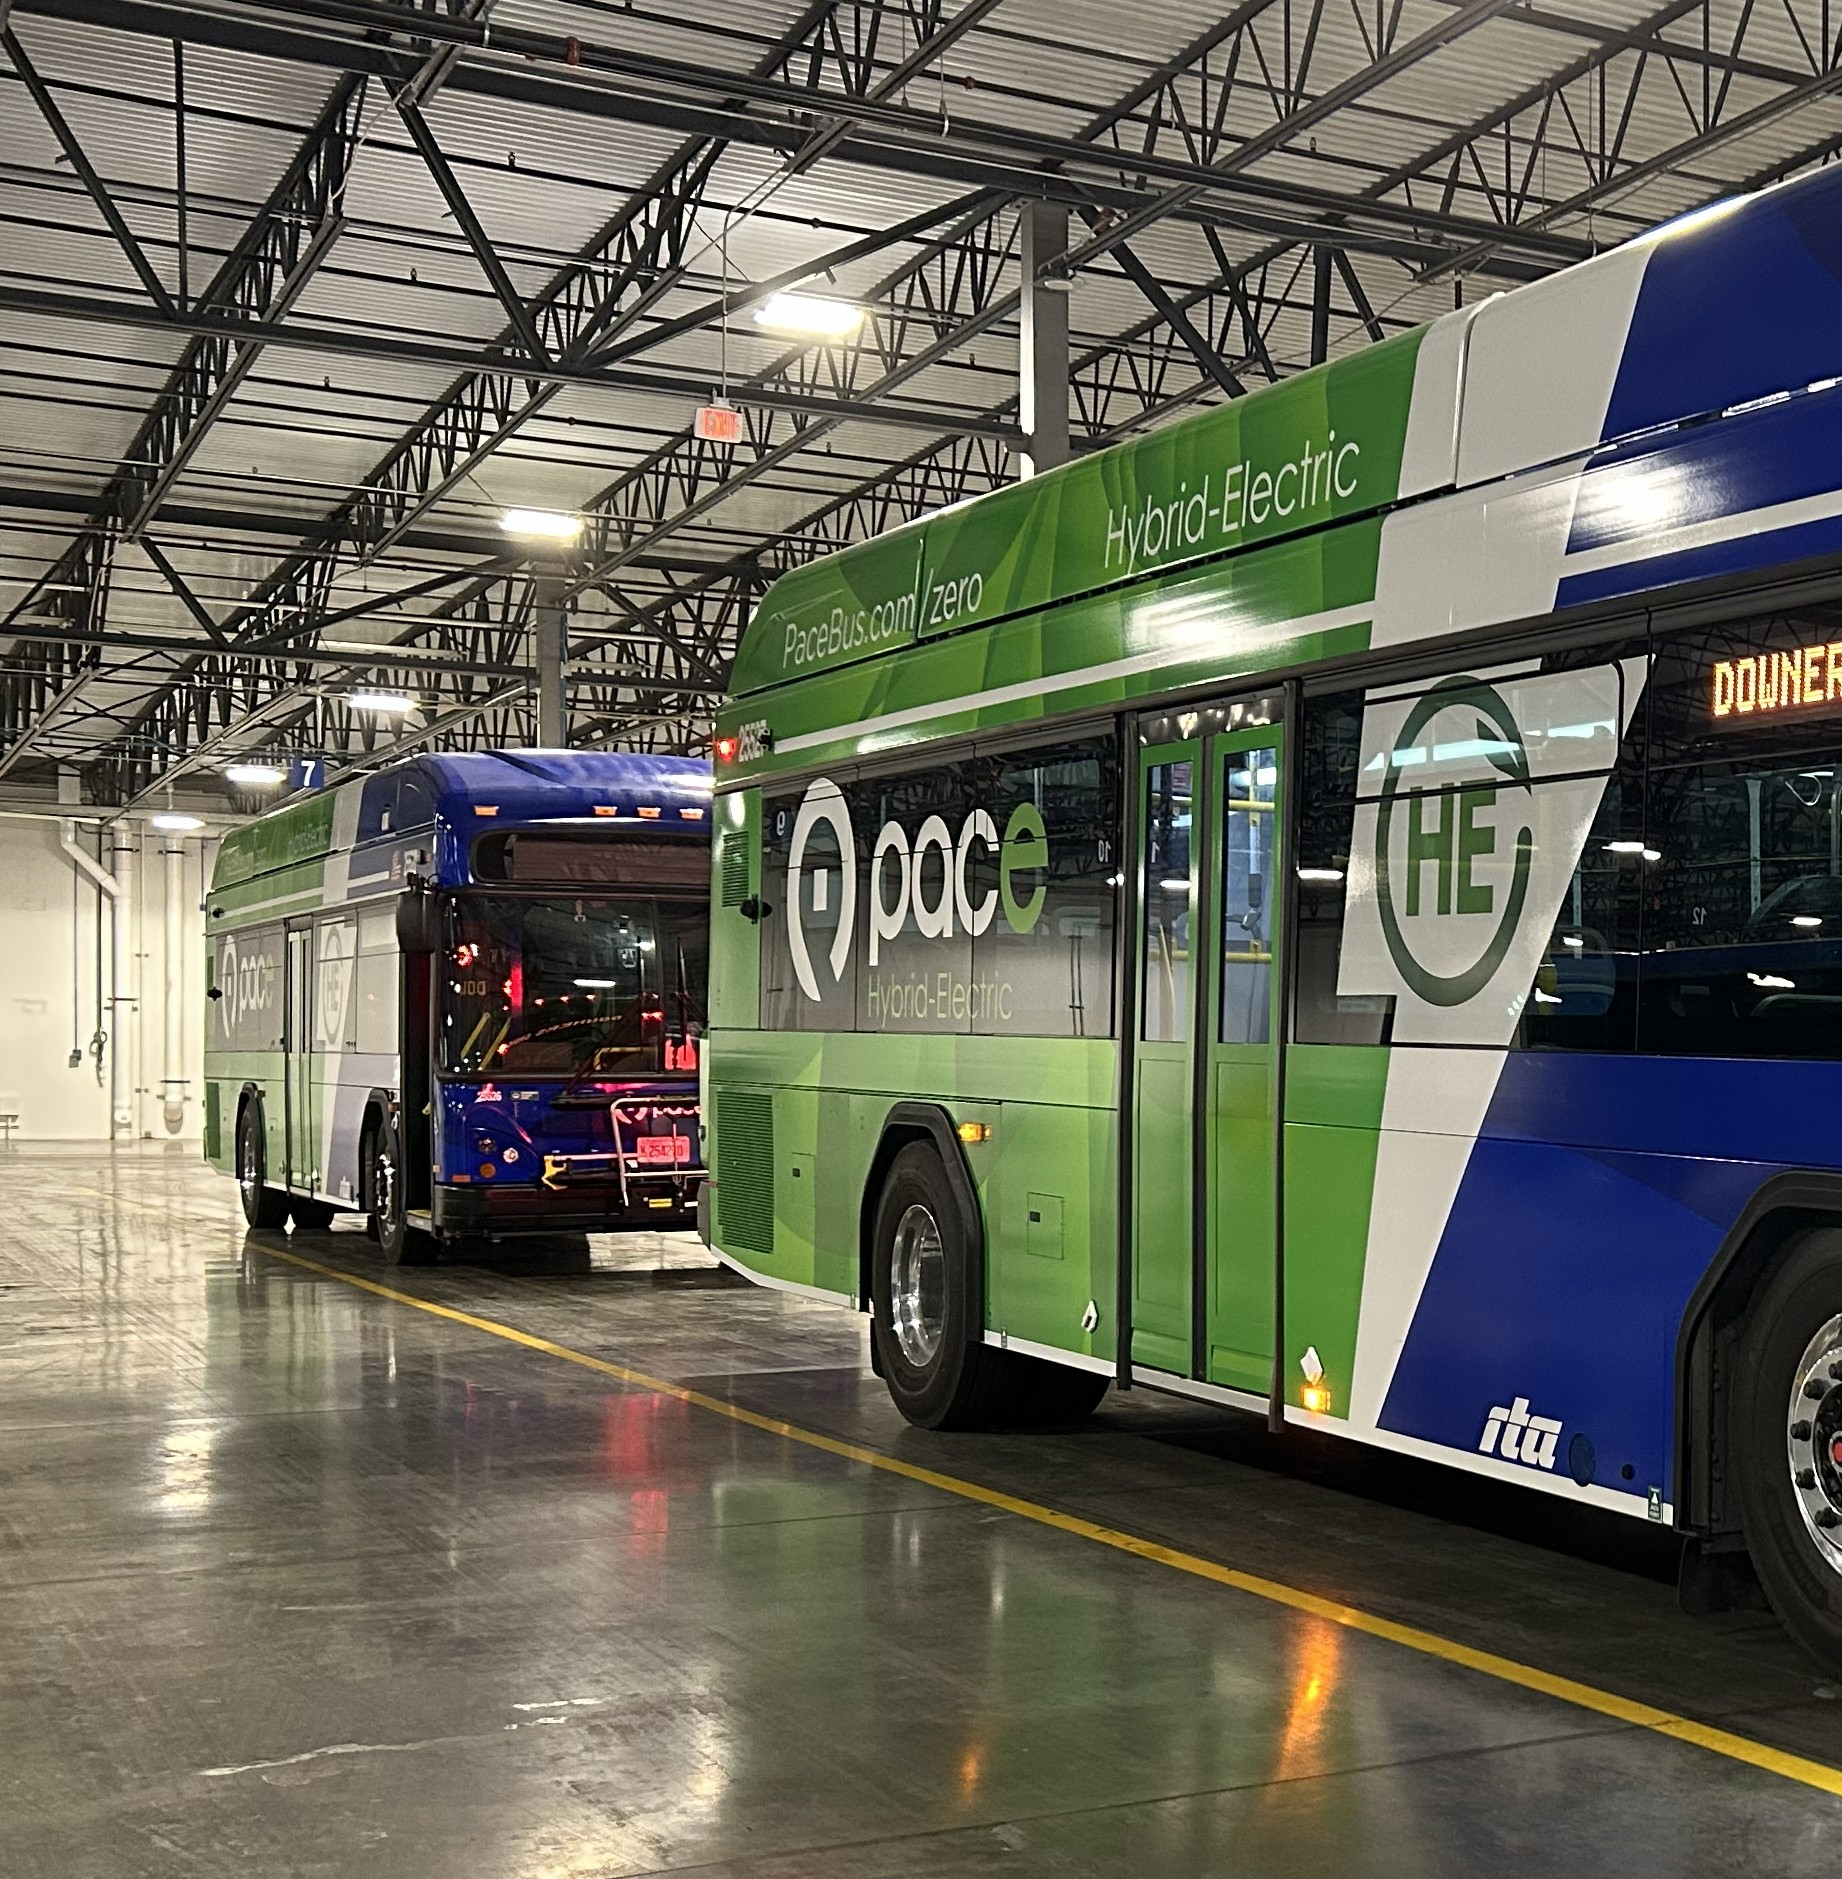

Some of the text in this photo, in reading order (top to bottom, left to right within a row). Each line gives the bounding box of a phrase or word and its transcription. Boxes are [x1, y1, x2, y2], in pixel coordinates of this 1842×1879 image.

[705, 409, 737, 439] EXIT
[1104, 430, 1361, 573] Hybrid-Electric
[300, 760, 316, 787] 7
[1404, 777, 1500, 918] HE
[869, 801, 1049, 967] pace
[239, 952, 274, 1022] pace
[867, 971, 1013, 1025] Hybrid-Electric
[1478, 1396, 1563, 1470] rta
